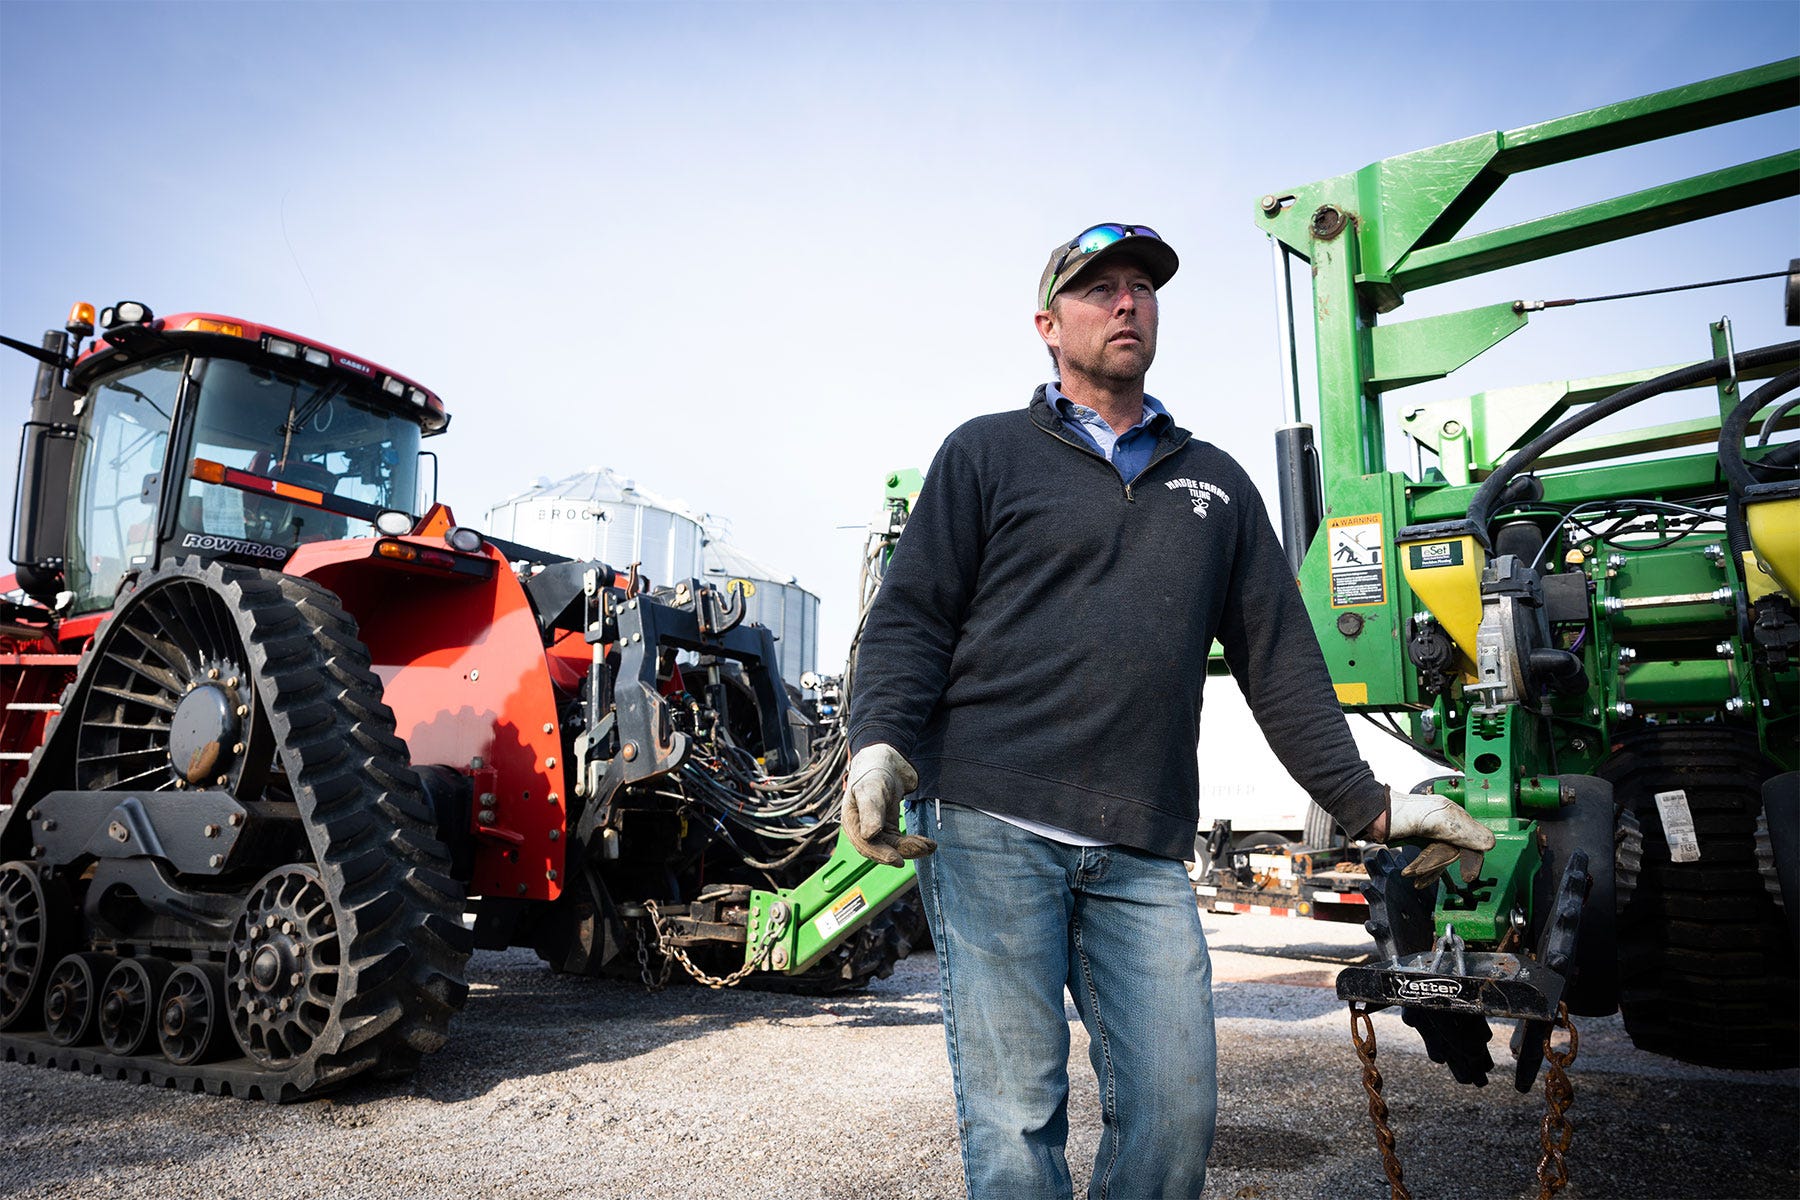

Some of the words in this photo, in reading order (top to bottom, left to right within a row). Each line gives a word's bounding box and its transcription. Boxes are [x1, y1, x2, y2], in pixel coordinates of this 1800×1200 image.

[1199, 481, 1230, 505] FARMS
[1341, 515, 1379, 526] WARNING
[182, 533, 287, 560] ROWTRAC
[1423, 545, 1447, 556] eSet
[1396, 978, 1459, 994] Yetter
